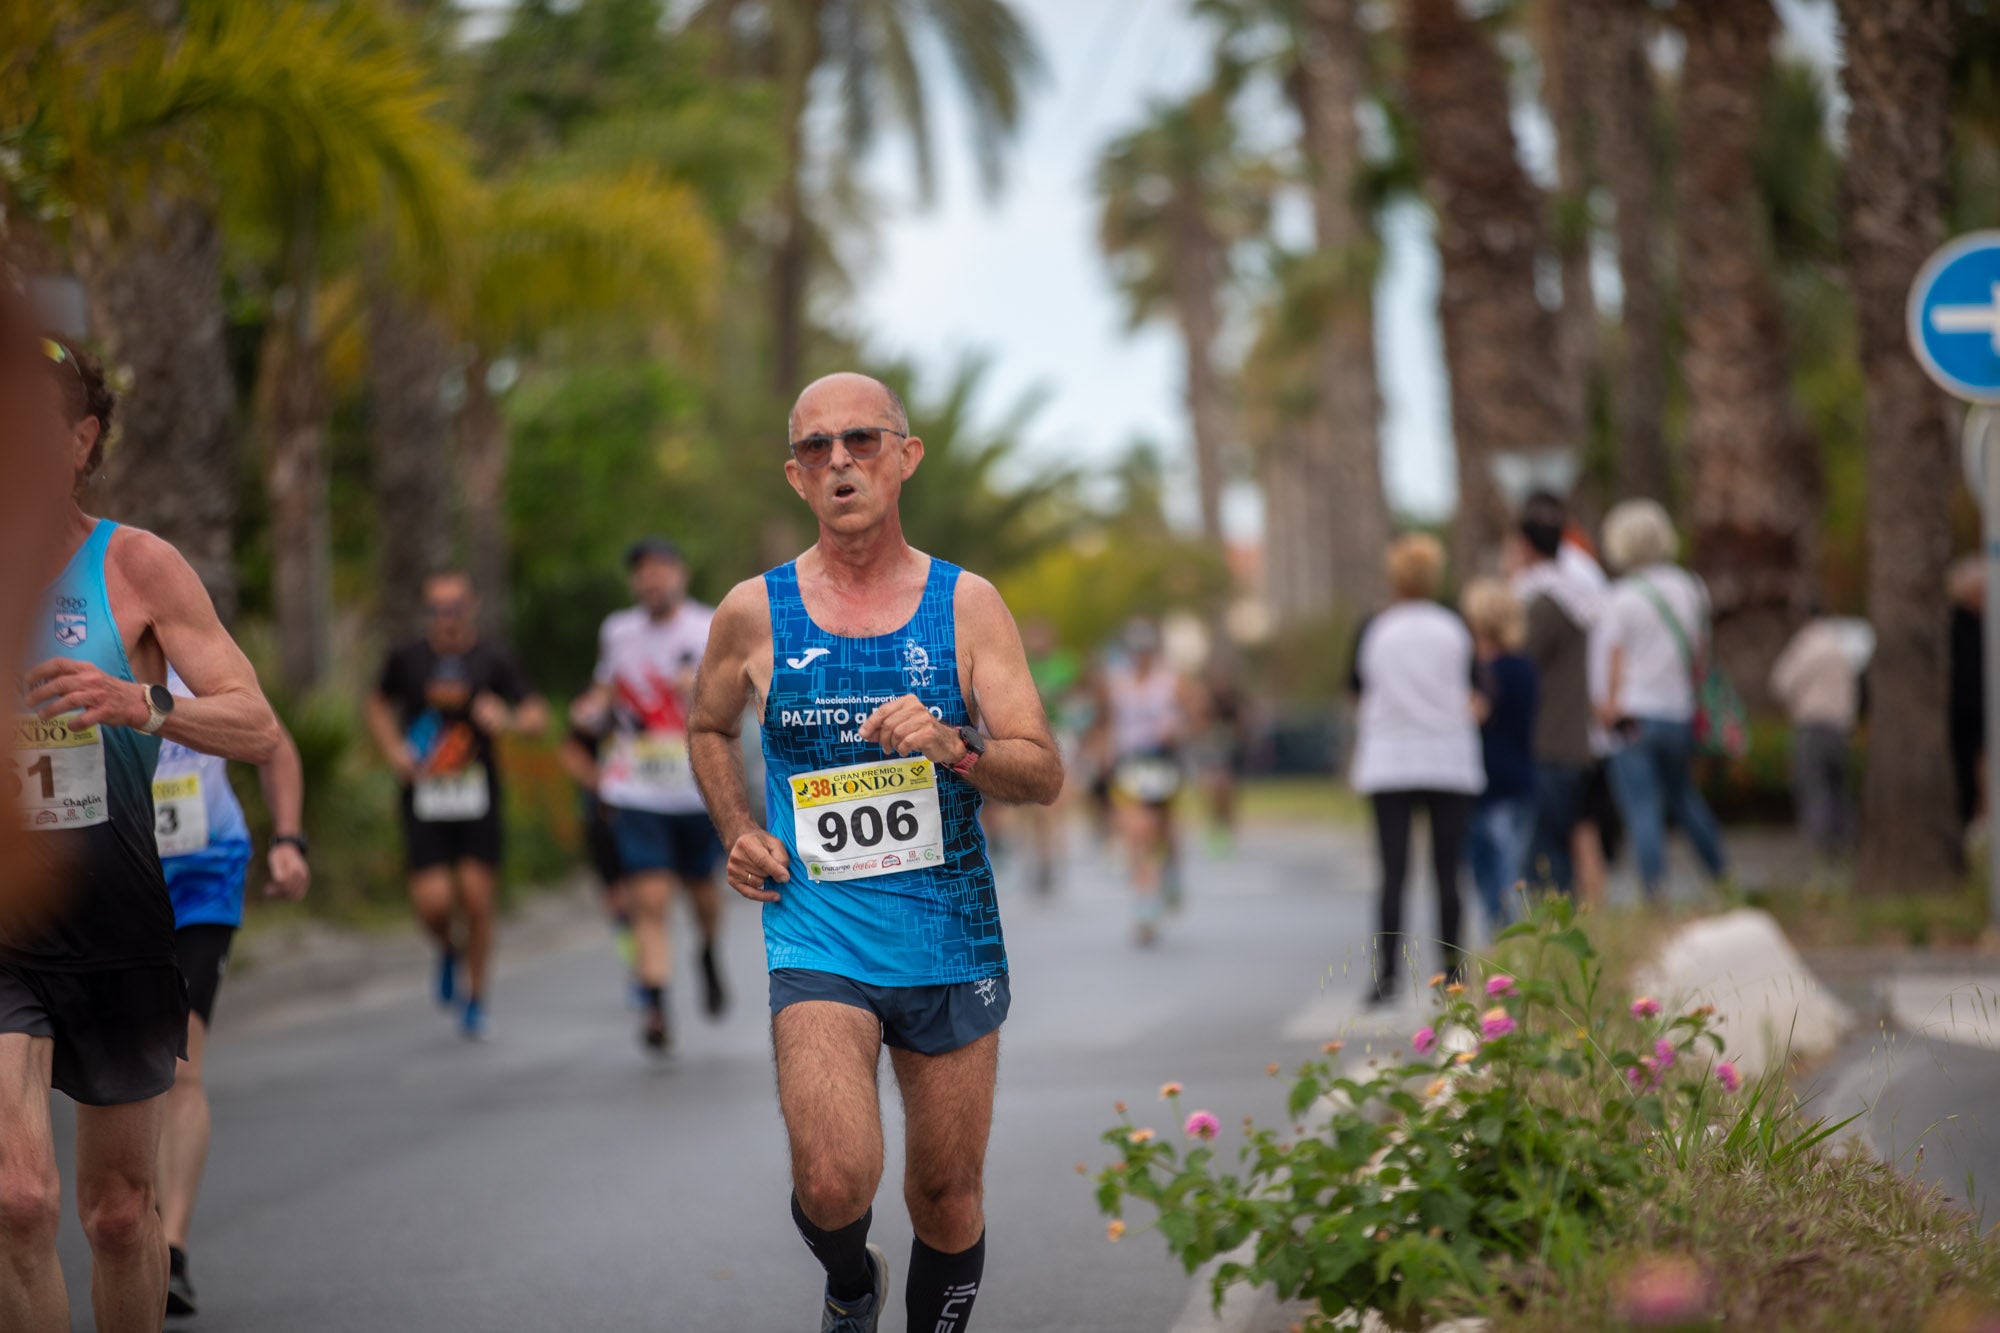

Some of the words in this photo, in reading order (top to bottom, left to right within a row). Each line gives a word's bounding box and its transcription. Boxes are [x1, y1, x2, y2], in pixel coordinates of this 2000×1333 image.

[815, 696, 862, 705] Asociación
[863, 694, 903, 704] Deportiv
[781, 708, 850, 727] PAZITO
[833, 772, 860, 782] GRAN
[861, 766, 897, 778] PREMIO
[810, 778, 831, 798] 38
[831, 773, 905, 797] FONDO
[817, 799, 919, 853] 906
